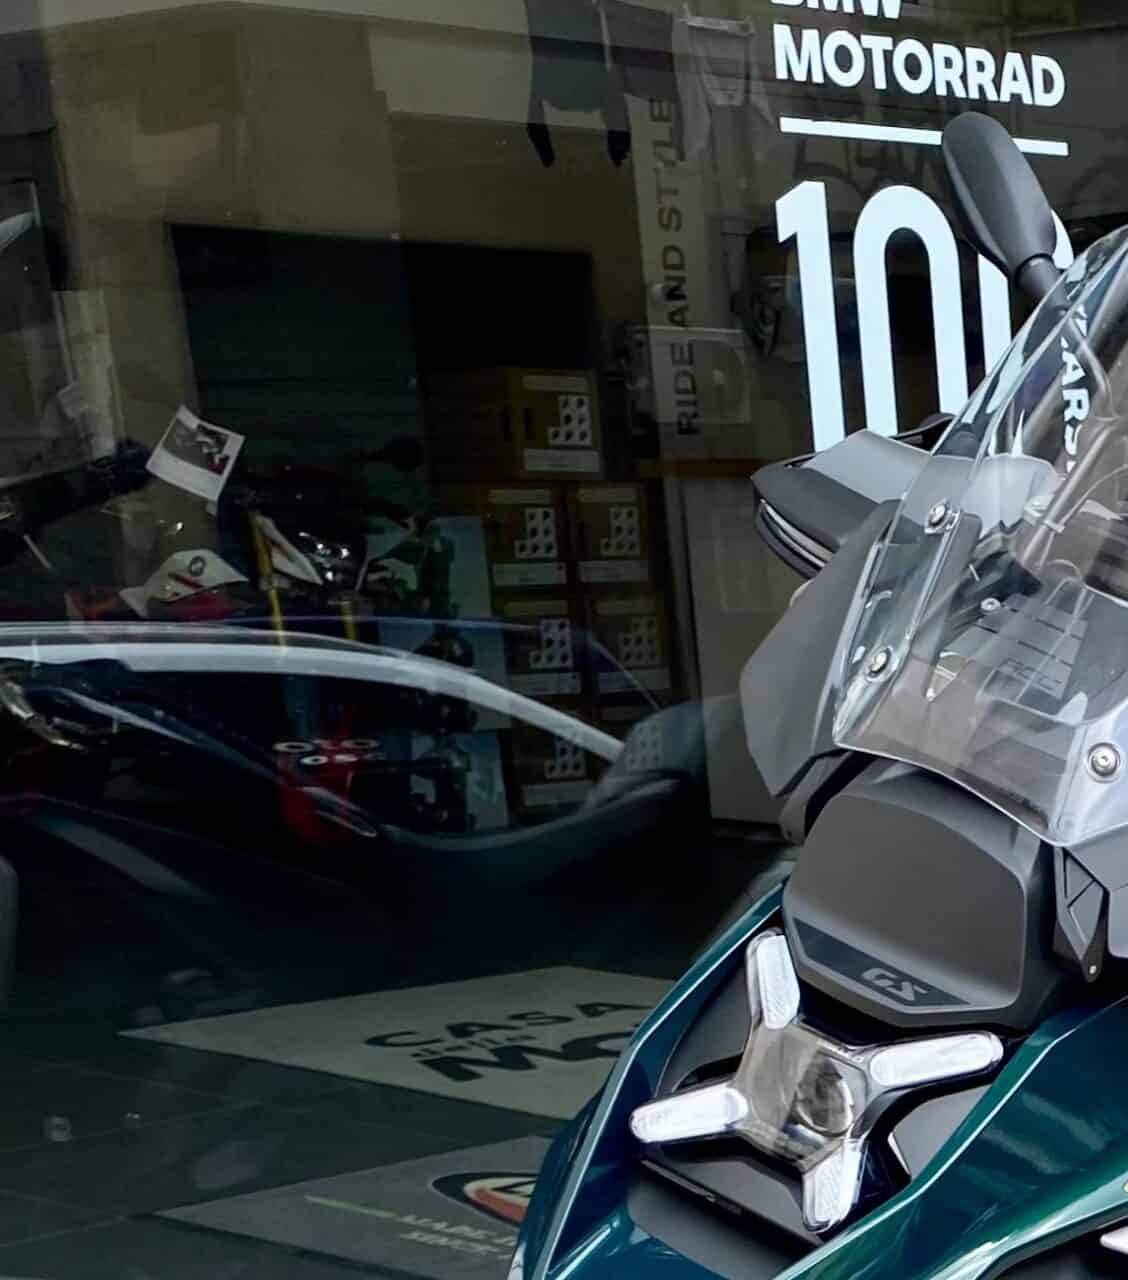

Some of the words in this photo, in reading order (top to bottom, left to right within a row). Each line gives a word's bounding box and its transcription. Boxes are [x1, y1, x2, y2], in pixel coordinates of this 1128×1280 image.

[772, 23, 1066, 107] MOTORRAD
[651, 98, 683, 232] STYLE
[662, 244, 688, 329] AND
[670, 340, 700, 435] RIDE
[363, 1001, 651, 1048] CASA
[860, 967, 929, 1002] GS
[417, 1023, 641, 1083] MO
